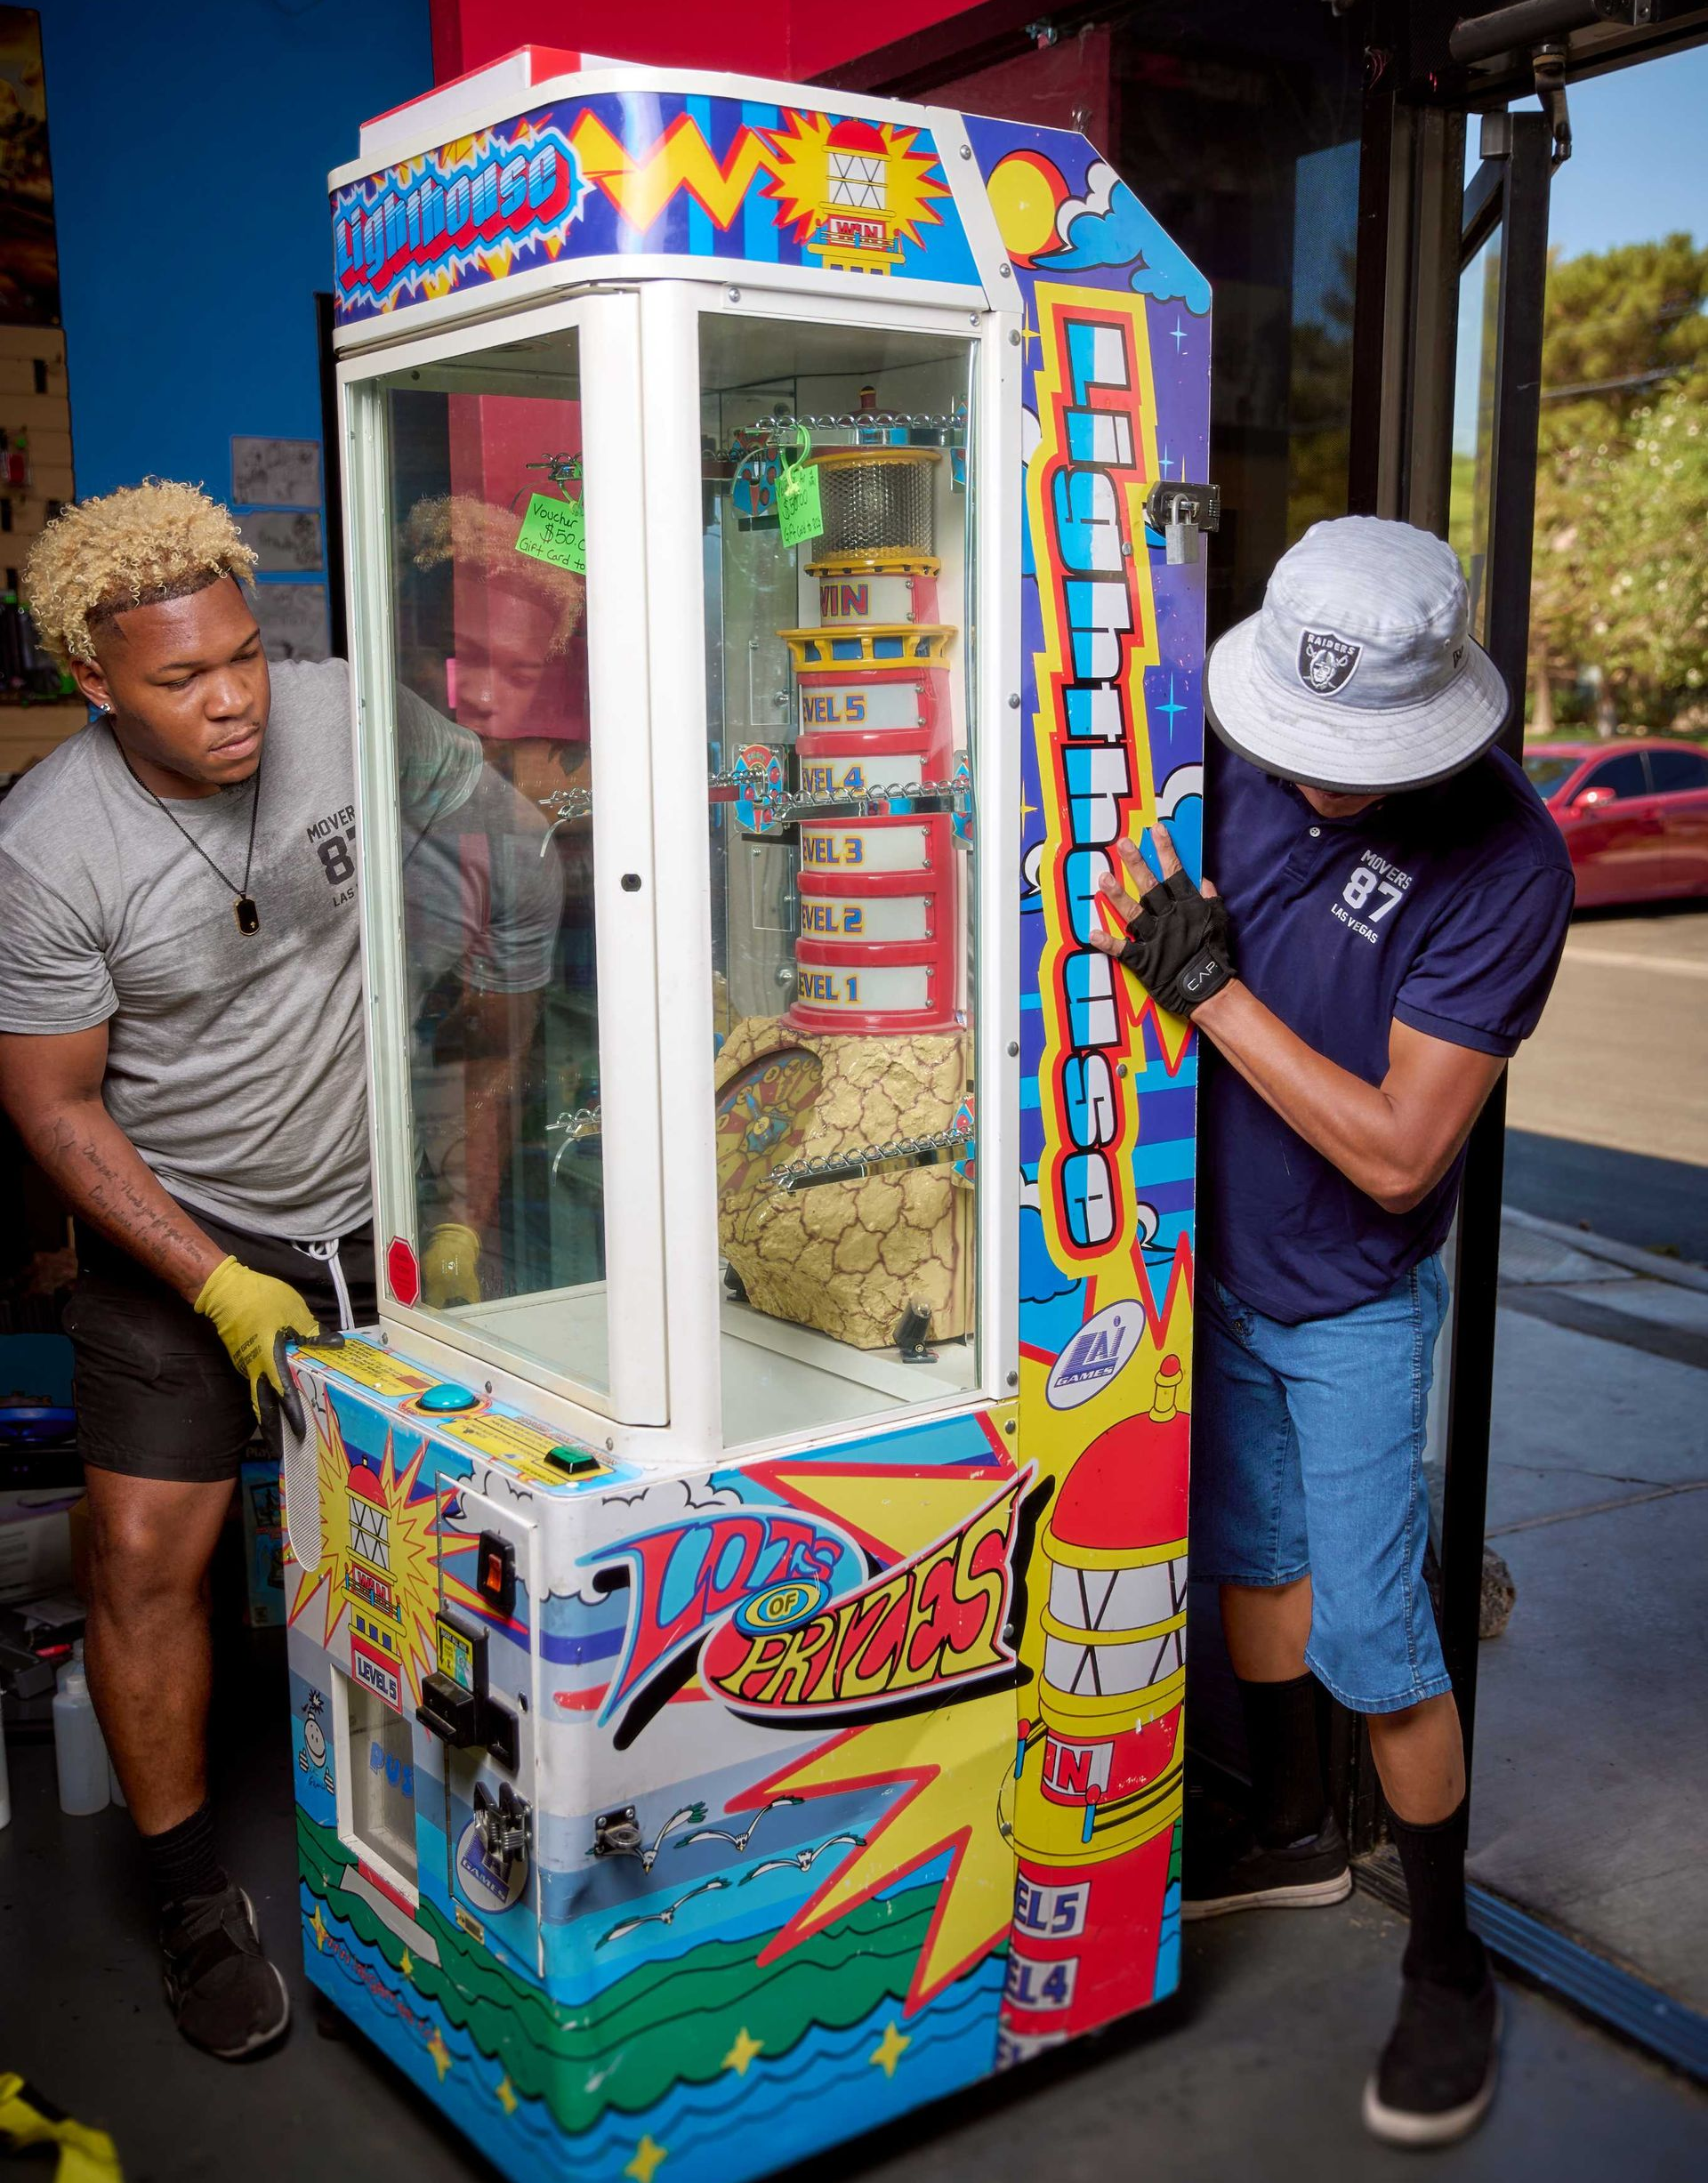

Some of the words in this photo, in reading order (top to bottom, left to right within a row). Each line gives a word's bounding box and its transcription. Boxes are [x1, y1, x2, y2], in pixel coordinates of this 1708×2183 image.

[336, 142, 570, 293] Lighthouse
[534, 503, 578, 528] Voucher
[520, 537, 544, 557] Gift
[547, 550, 571, 566] Card
[1307, 632, 1356, 656] RAIDERS
[846, 695, 866, 721] 5
[843, 766, 865, 790] 4
[846, 837, 864, 864] 3
[1360, 850, 1413, 890] MOVERS
[333, 888, 355, 907] LAS
[1342, 866, 1403, 923] 87
[843, 907, 863, 933] 2
[1330, 903, 1349, 922] LAS
[1347, 916, 1379, 944] VEGAS
[846, 976, 858, 1002] 1
[1055, 1365, 1114, 1387] GAMES
[711, 1486, 1025, 1704] PRIZES
[769, 1592, 797, 1618] OF
[583, 1514, 844, 1724] LOTS
[358, 1655, 389, 1696] LEVEL
[389, 1678, 397, 1701] 5
[462, 1858, 507, 1902] GAMES
[1051, 1891, 1079, 1934] 5
[1041, 1963, 1068, 2006] 4
